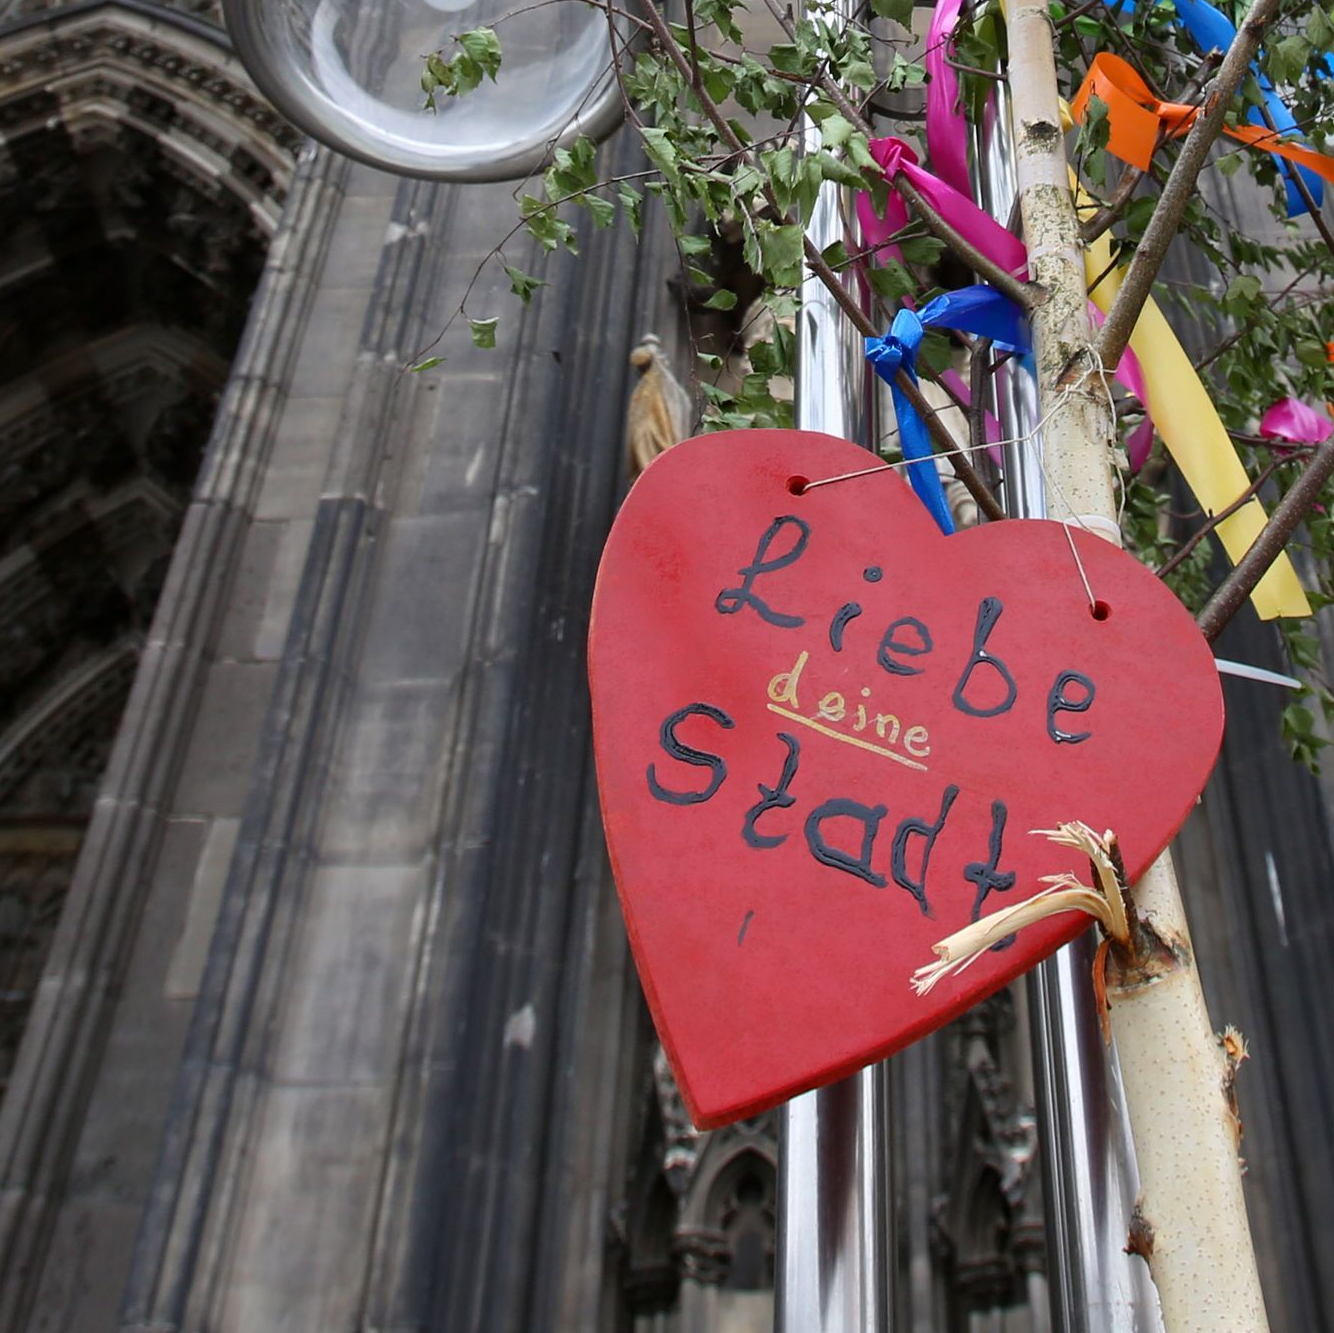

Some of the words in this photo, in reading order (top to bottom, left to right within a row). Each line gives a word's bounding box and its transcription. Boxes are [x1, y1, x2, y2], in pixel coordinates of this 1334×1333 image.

[715, 515, 1095, 744] Liebe
[768, 651, 931, 758] deine
[646, 703, 1016, 951] Stadt
